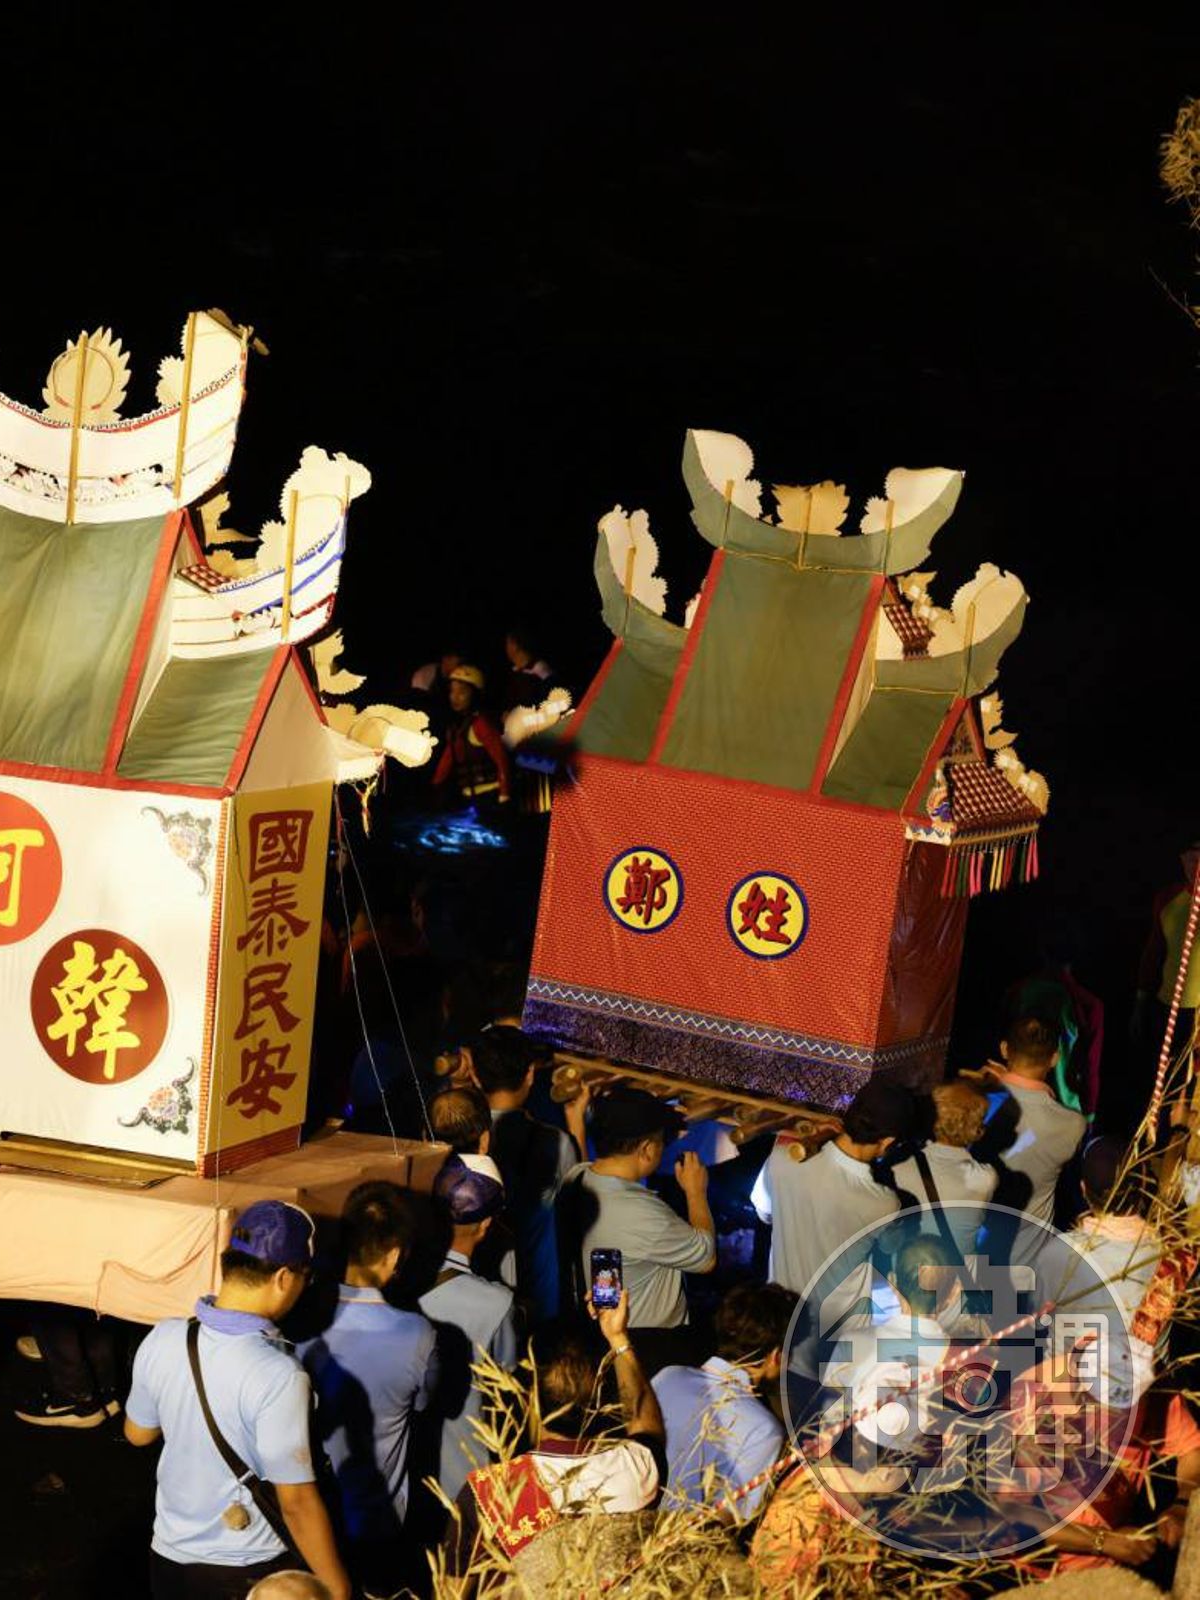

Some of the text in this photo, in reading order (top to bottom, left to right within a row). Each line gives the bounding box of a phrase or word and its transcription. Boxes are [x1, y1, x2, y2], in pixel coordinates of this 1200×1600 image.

[226, 809, 314, 1119] 國泰民安
[616, 856, 792, 945] 鄭 姓
[46, 940, 149, 1079] 韓
